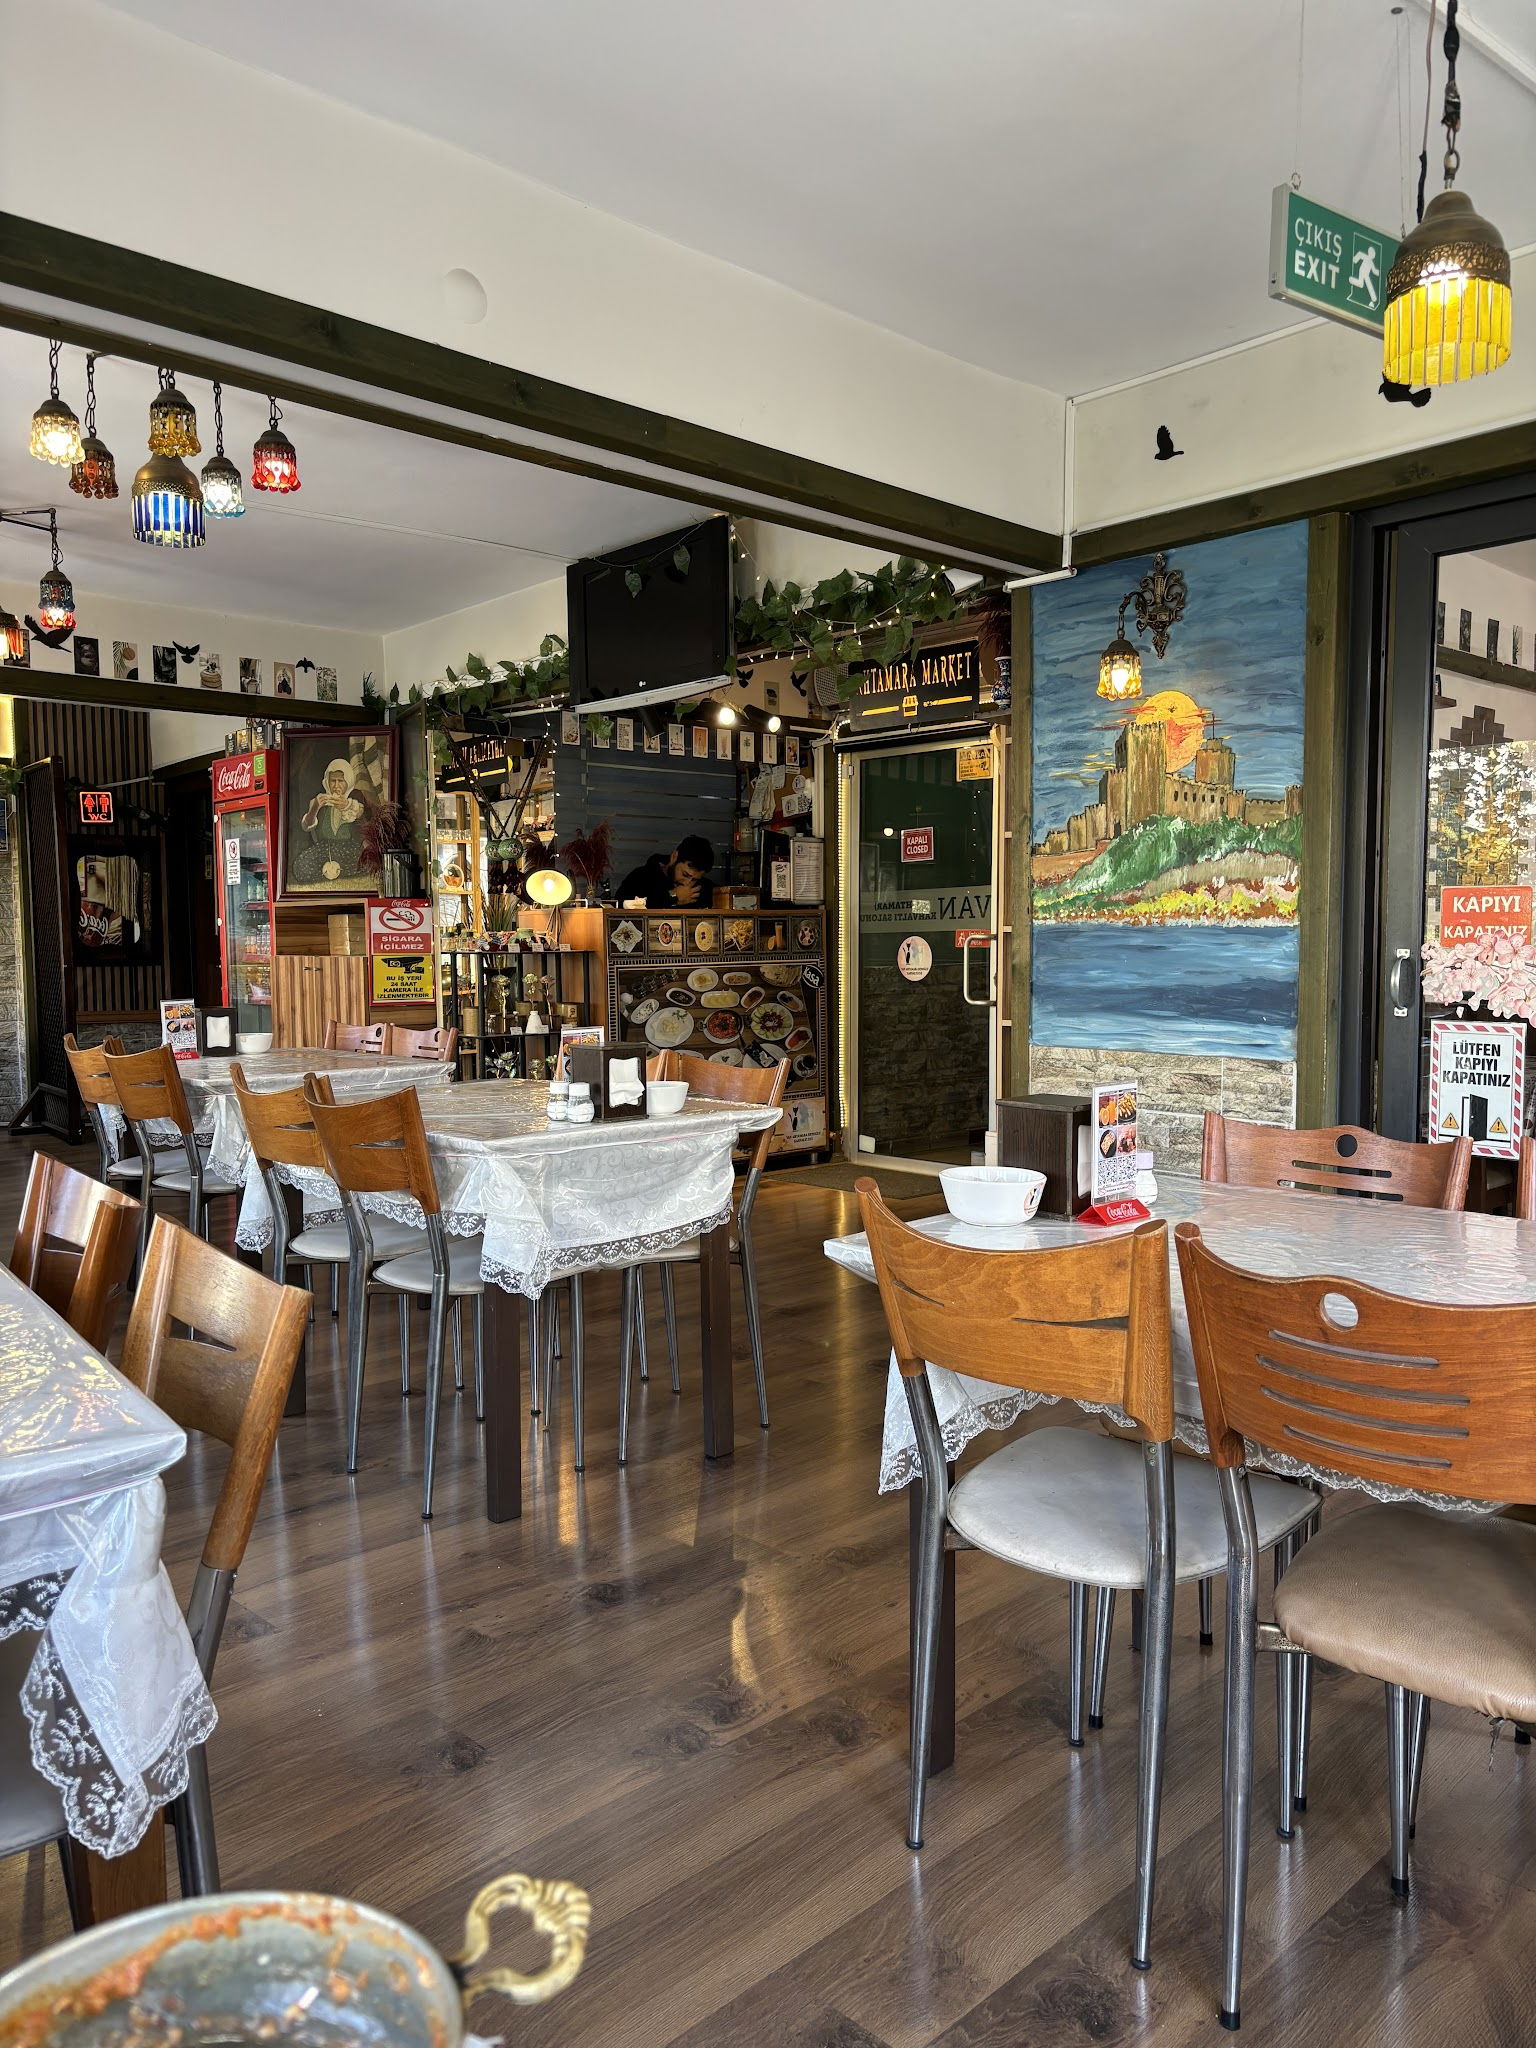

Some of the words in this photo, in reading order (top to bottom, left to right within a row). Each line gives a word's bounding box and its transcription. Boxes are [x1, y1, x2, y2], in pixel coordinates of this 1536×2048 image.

[1295, 217, 1342, 263] ÇIKIŞ
[1295, 249, 1340, 289] EXIT
[921, 651, 972, 687] MARKET
[88, 813, 108, 821] WC
[907, 835, 928, 846] KAPALI
[907, 844, 929, 855] CLOSED
[1453, 895, 1521, 914] KAPIYI
[381, 934, 422, 942] SİGARA
[380, 943, 424, 951] İÇİLMEZ
[1453, 1041, 1501, 1058] LÜTFEN
[1455, 1056, 1498, 1072] KAPIYI
[1442, 1070, 1511, 1088] KAPATINIZ
